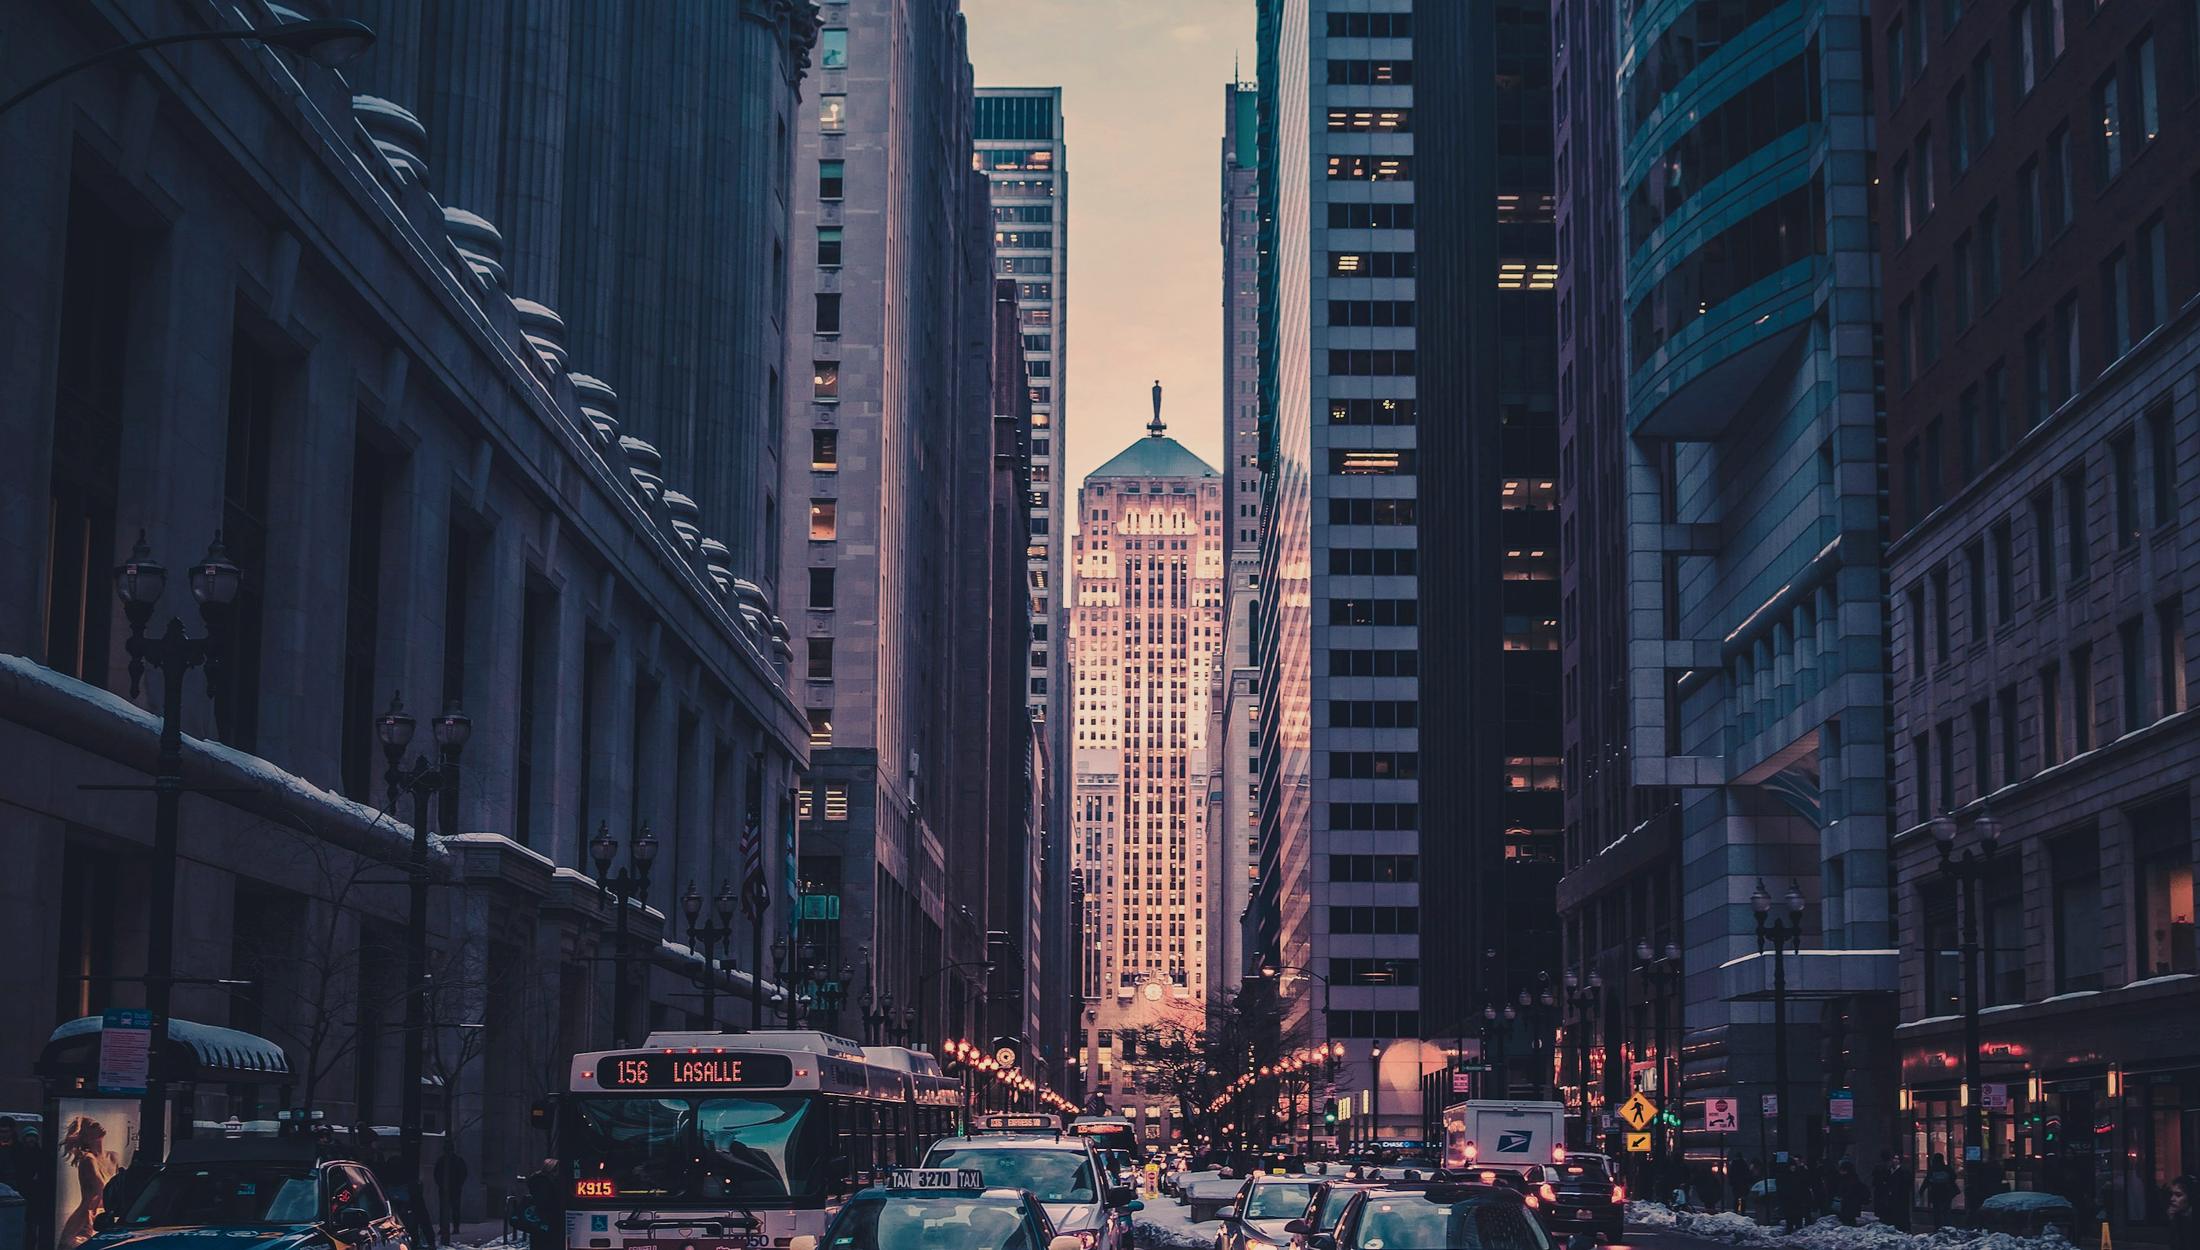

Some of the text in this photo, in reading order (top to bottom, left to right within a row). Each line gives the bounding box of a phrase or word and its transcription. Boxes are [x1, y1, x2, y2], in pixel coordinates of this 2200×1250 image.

[617, 1060, 742, 1084] 156 LASALLE
[892, 1171, 980, 1188] TAXI 3270 TAXI
[577, 1182, 612, 1195] K915
